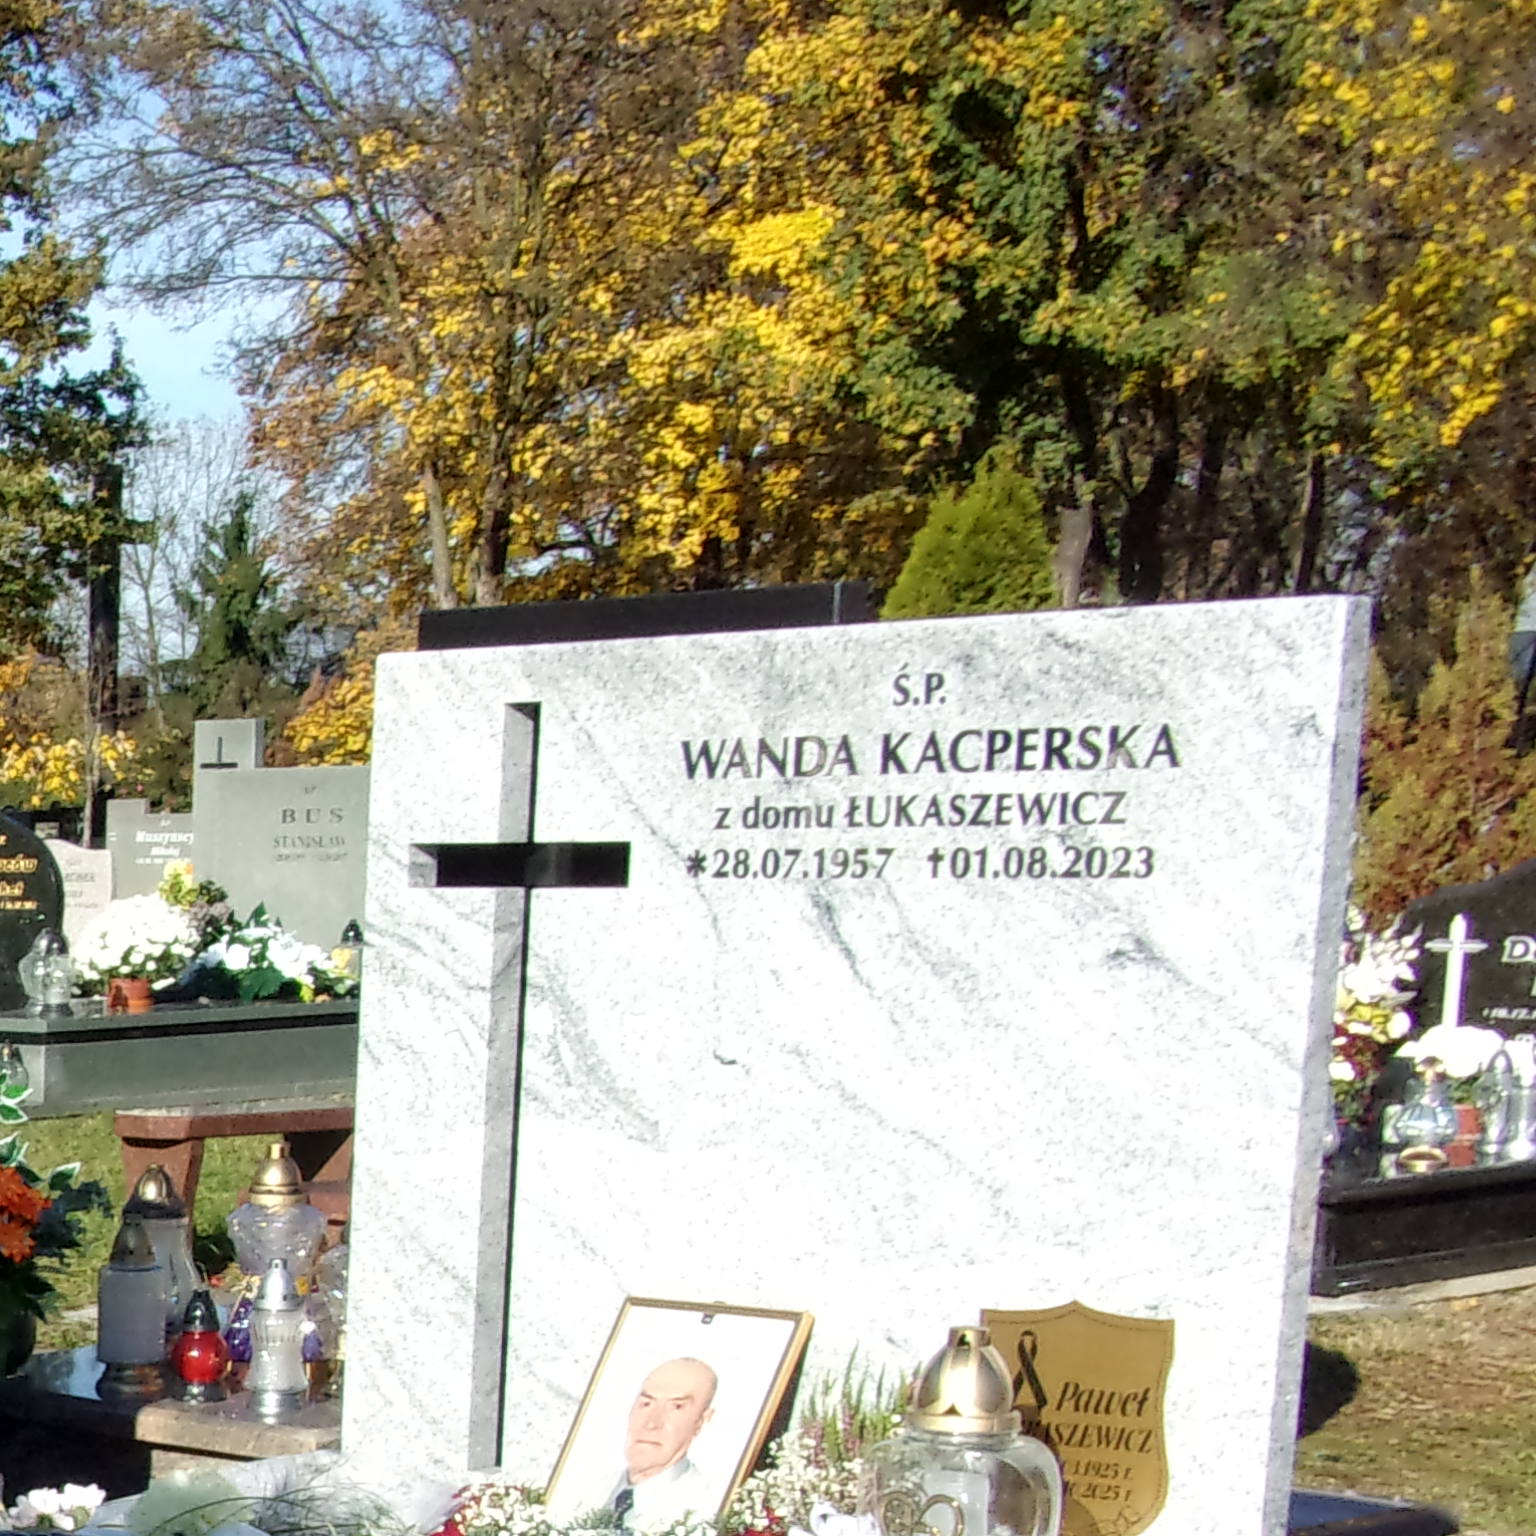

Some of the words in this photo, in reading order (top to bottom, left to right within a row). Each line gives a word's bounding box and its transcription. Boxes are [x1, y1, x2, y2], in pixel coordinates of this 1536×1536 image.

[679, 733, 860, 780] WANDA
[878, 723, 1182, 777] KACPERSKA
[713, 807, 732, 831] z
[741, 796, 835, 830] domu
[844, 790, 1128, 829] ŁUKASZEWICZ
